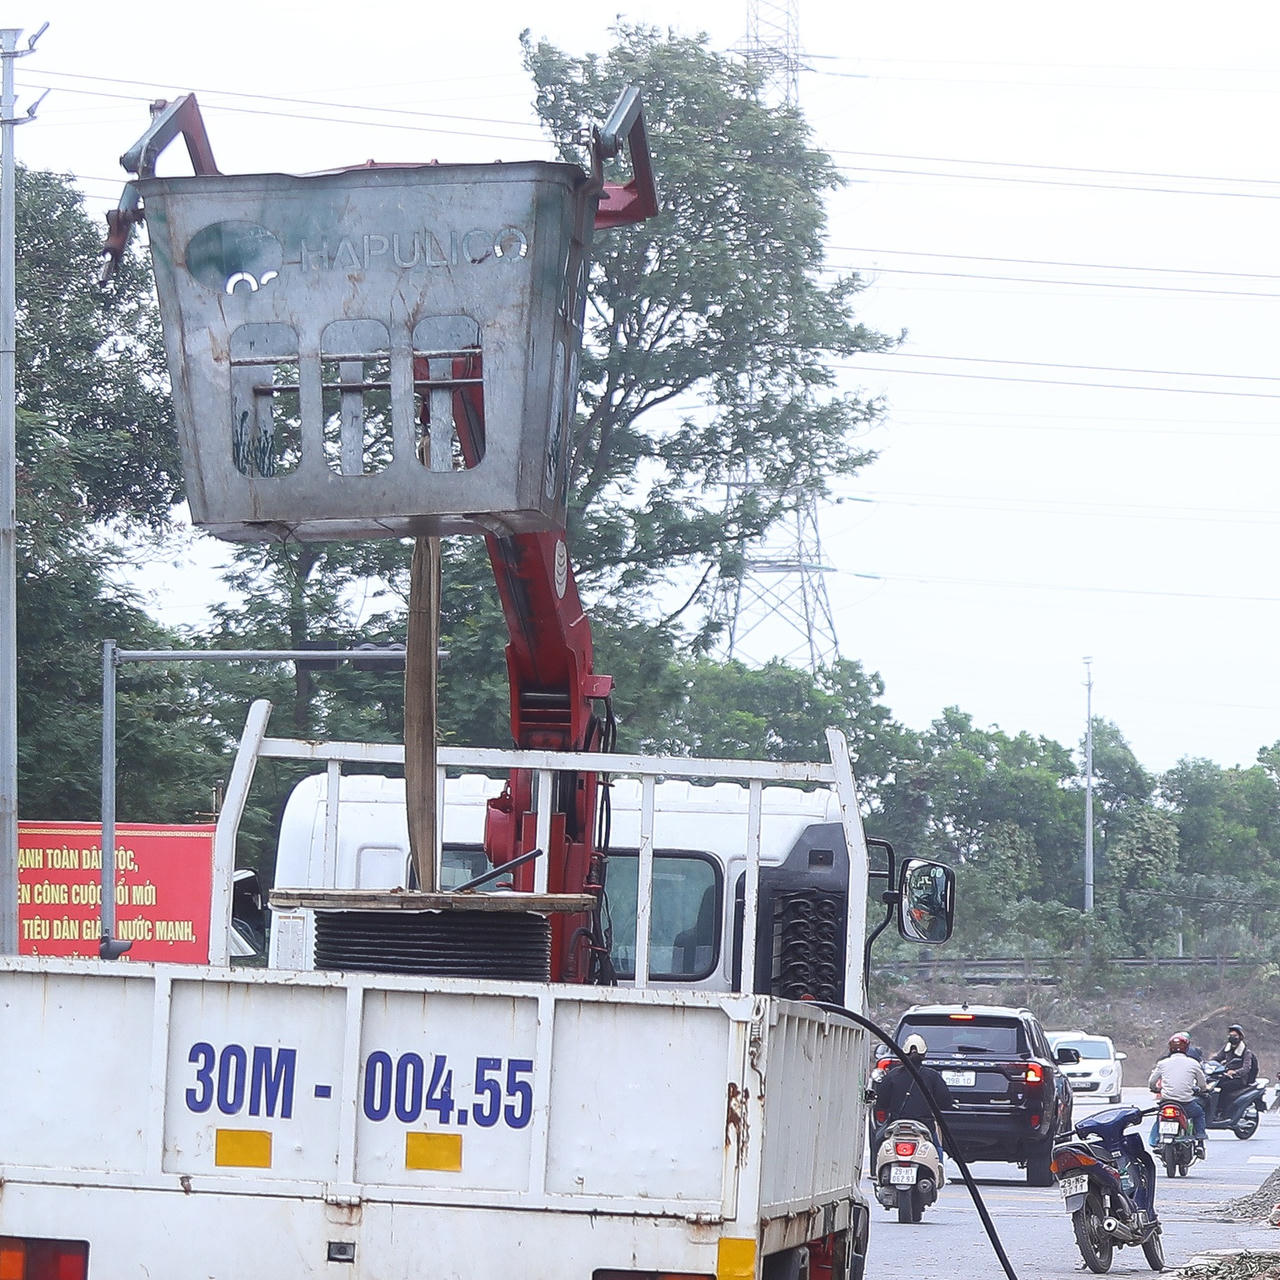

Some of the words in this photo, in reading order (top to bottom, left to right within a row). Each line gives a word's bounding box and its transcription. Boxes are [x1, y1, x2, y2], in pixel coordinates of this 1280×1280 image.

[18, 848, 44, 872] ẠNH
[46, 845, 79, 870] TOÀN
[34, 880, 68, 905] CÔNG
[115, 878, 129, 905] ỔI
[132, 880, 157, 905] MỚI
[23, 915, 49, 940] TIÊU
[53, 915, 79, 940] DÂN
[82, 915, 102, 940] GIÀ
[119, 914, 153, 941] NƯỚC
[155, 920, 196, 945] MẠNH,
[185, 1042, 296, 1119] 30M
[363, 1051, 534, 1128] 004.55
